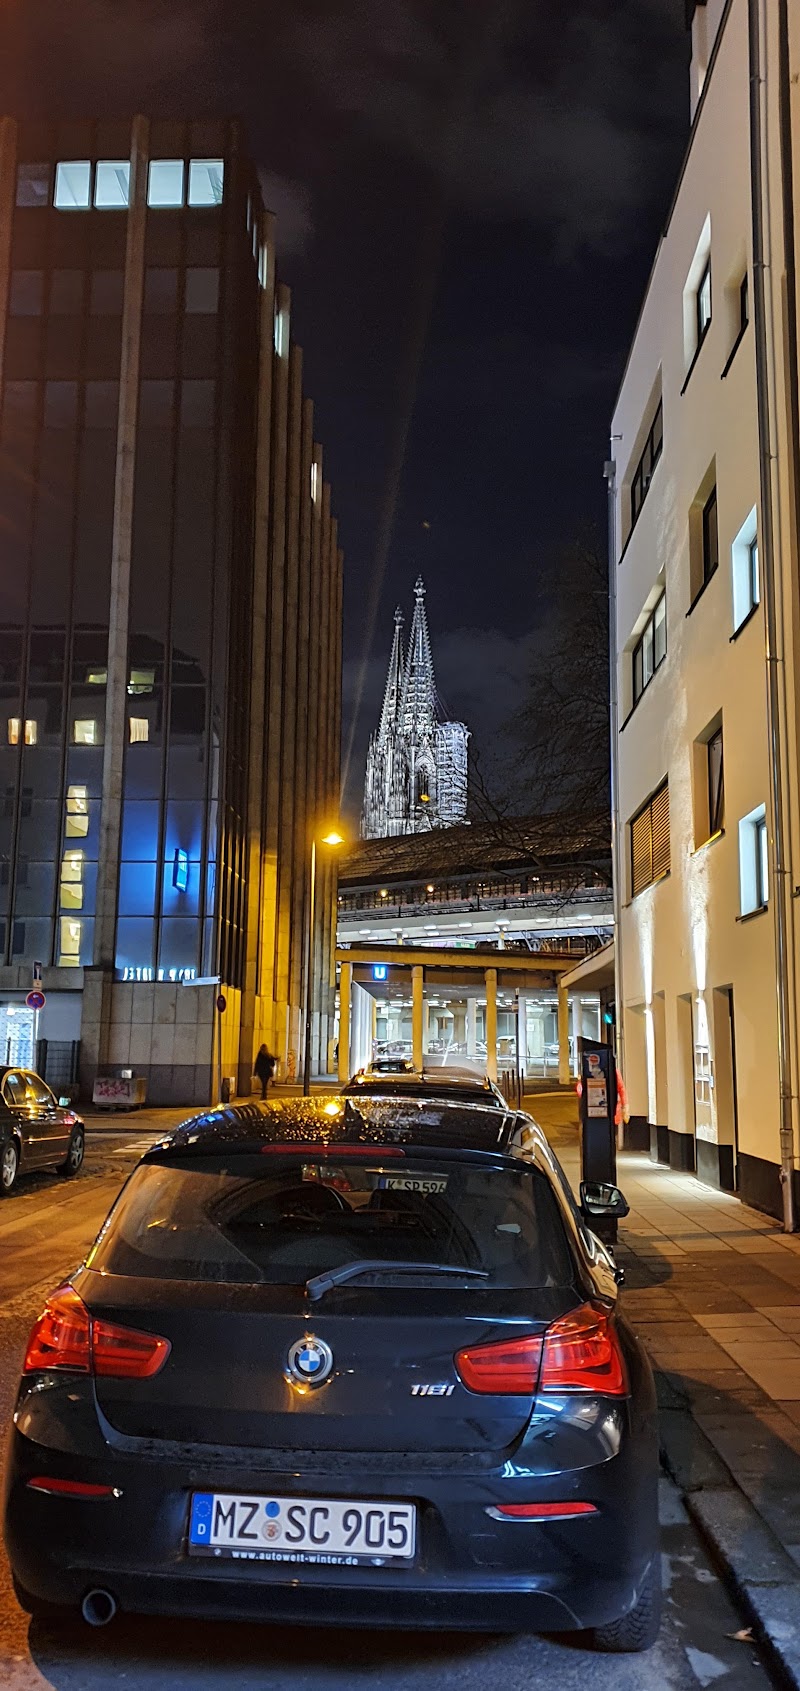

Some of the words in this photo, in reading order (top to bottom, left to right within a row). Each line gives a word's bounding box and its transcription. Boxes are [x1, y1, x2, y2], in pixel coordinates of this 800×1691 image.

[374, 966, 386, 979] U
[388, 1180, 396, 1190] K
[197, 1523, 206, 1535] D
[213, 1500, 260, 1539] MZ
[285, 1505, 330, 1545] SC
[342, 1509, 409, 1549] 905
[231, 1550, 359, 1566] www.autowelt-winter.de
